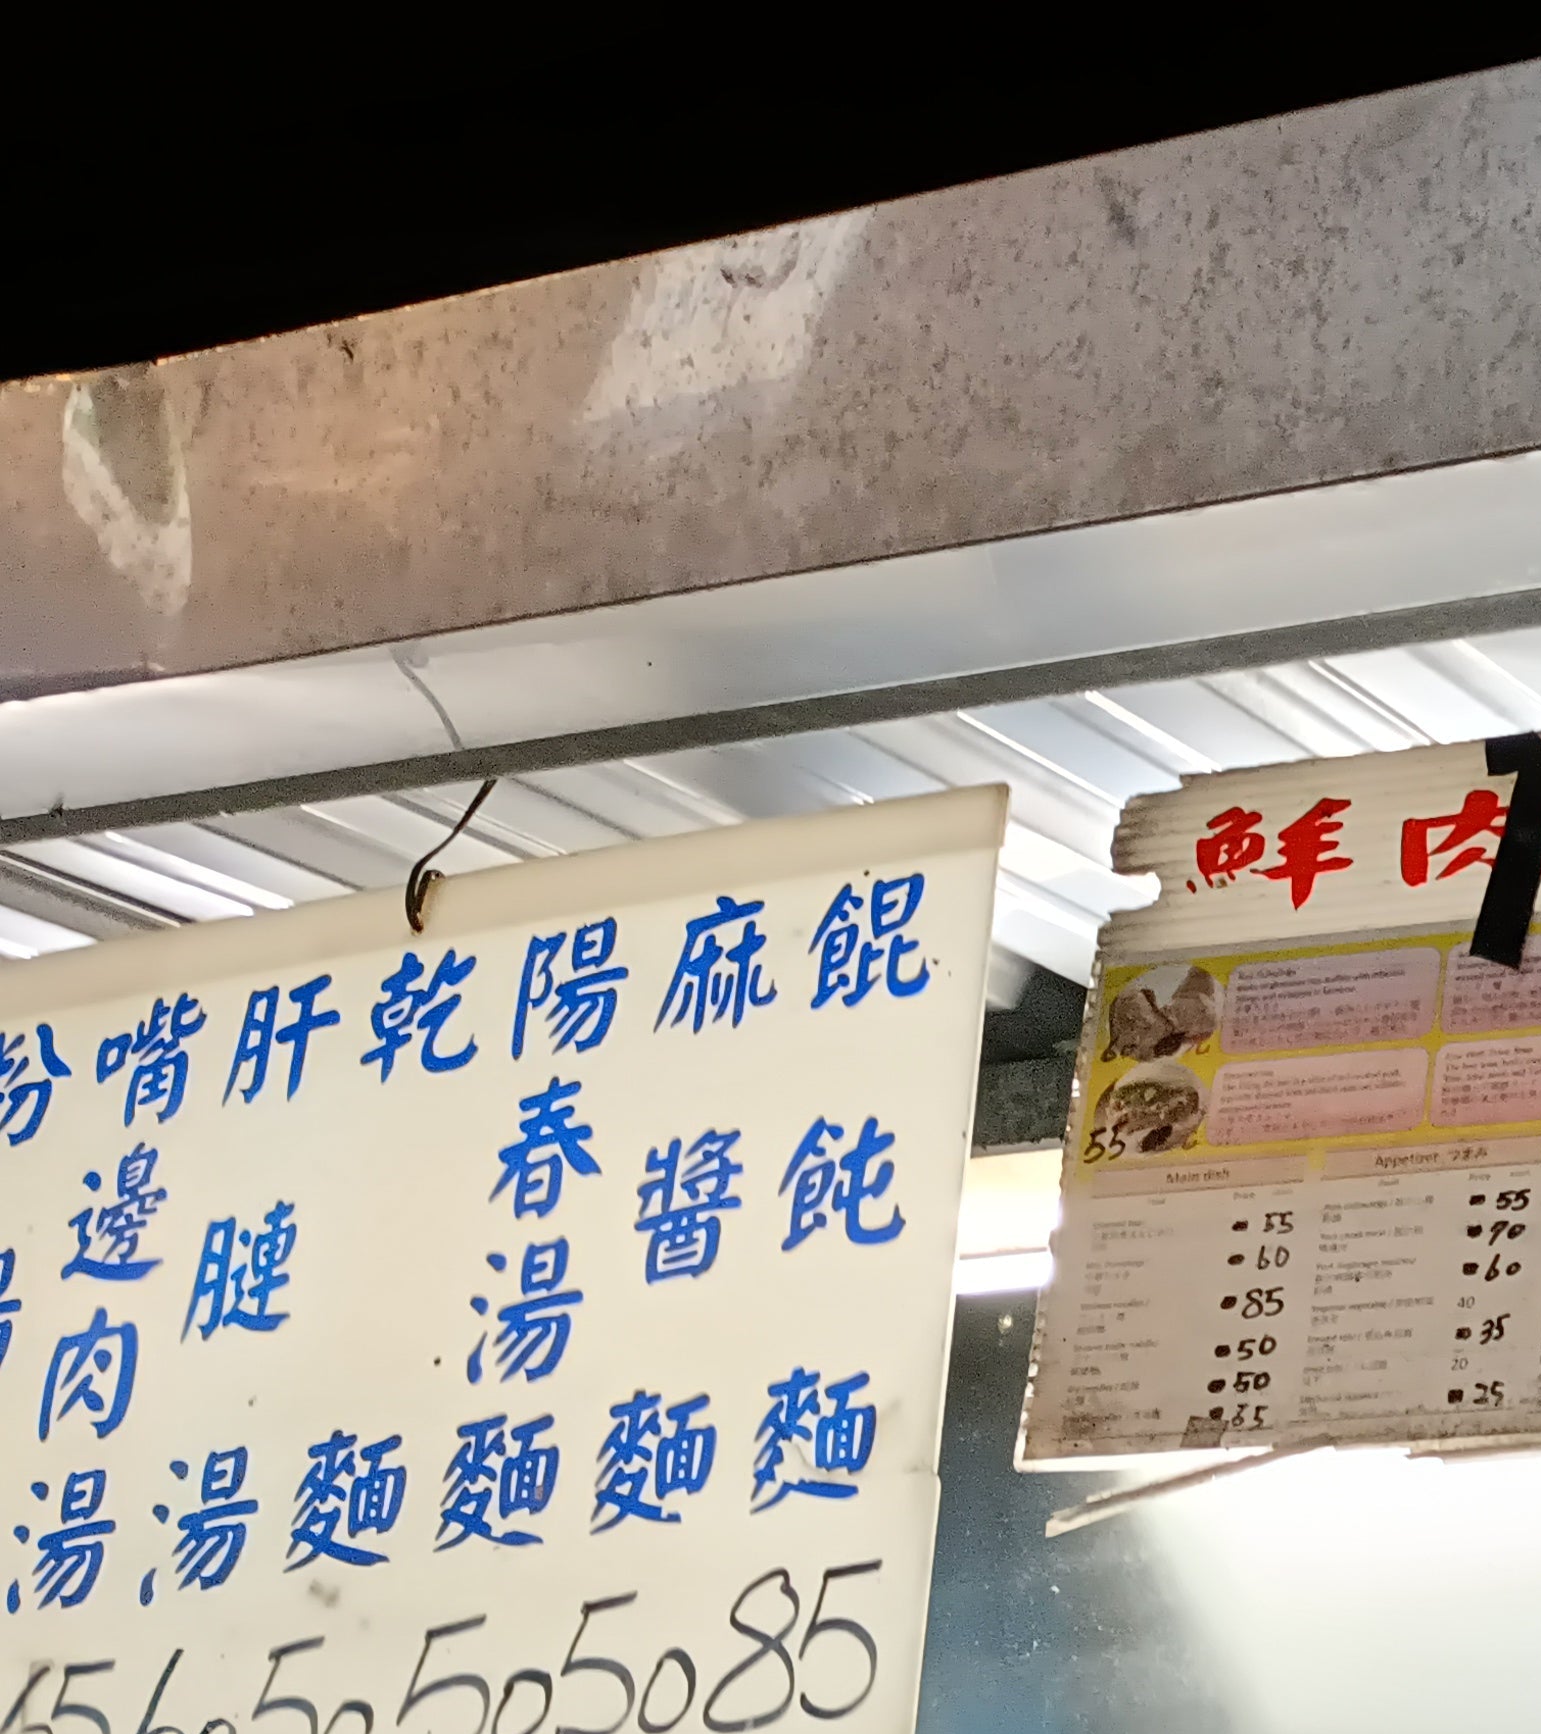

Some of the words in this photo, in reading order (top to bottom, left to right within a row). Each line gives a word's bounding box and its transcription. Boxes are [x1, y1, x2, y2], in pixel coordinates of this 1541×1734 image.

[1375, 1152, 1439, 1168] Appetizer
[750, 874, 928, 1513] 餛飩麵
[1496, 1188, 1531, 1211] 55
[591, 895, 778, 1535] 麻醬麵
[434, 917, 630, 1552] 陽春湯麵
[283, 946, 478, 1572] 乾麵
[1257, 1245, 1290, 1270] 60
[1484, 1253, 1522, 1282] 60
[5, 993, 207, 1608] 嘴邊肉湯
[1241, 1287, 1284, 1319] 85
[1480, 1313, 1511, 1345] 35
[1237, 1334, 1277, 1361] 50
[1451, 1357, 1468, 1370] 20
[703, 1559, 881, 1733] 85
